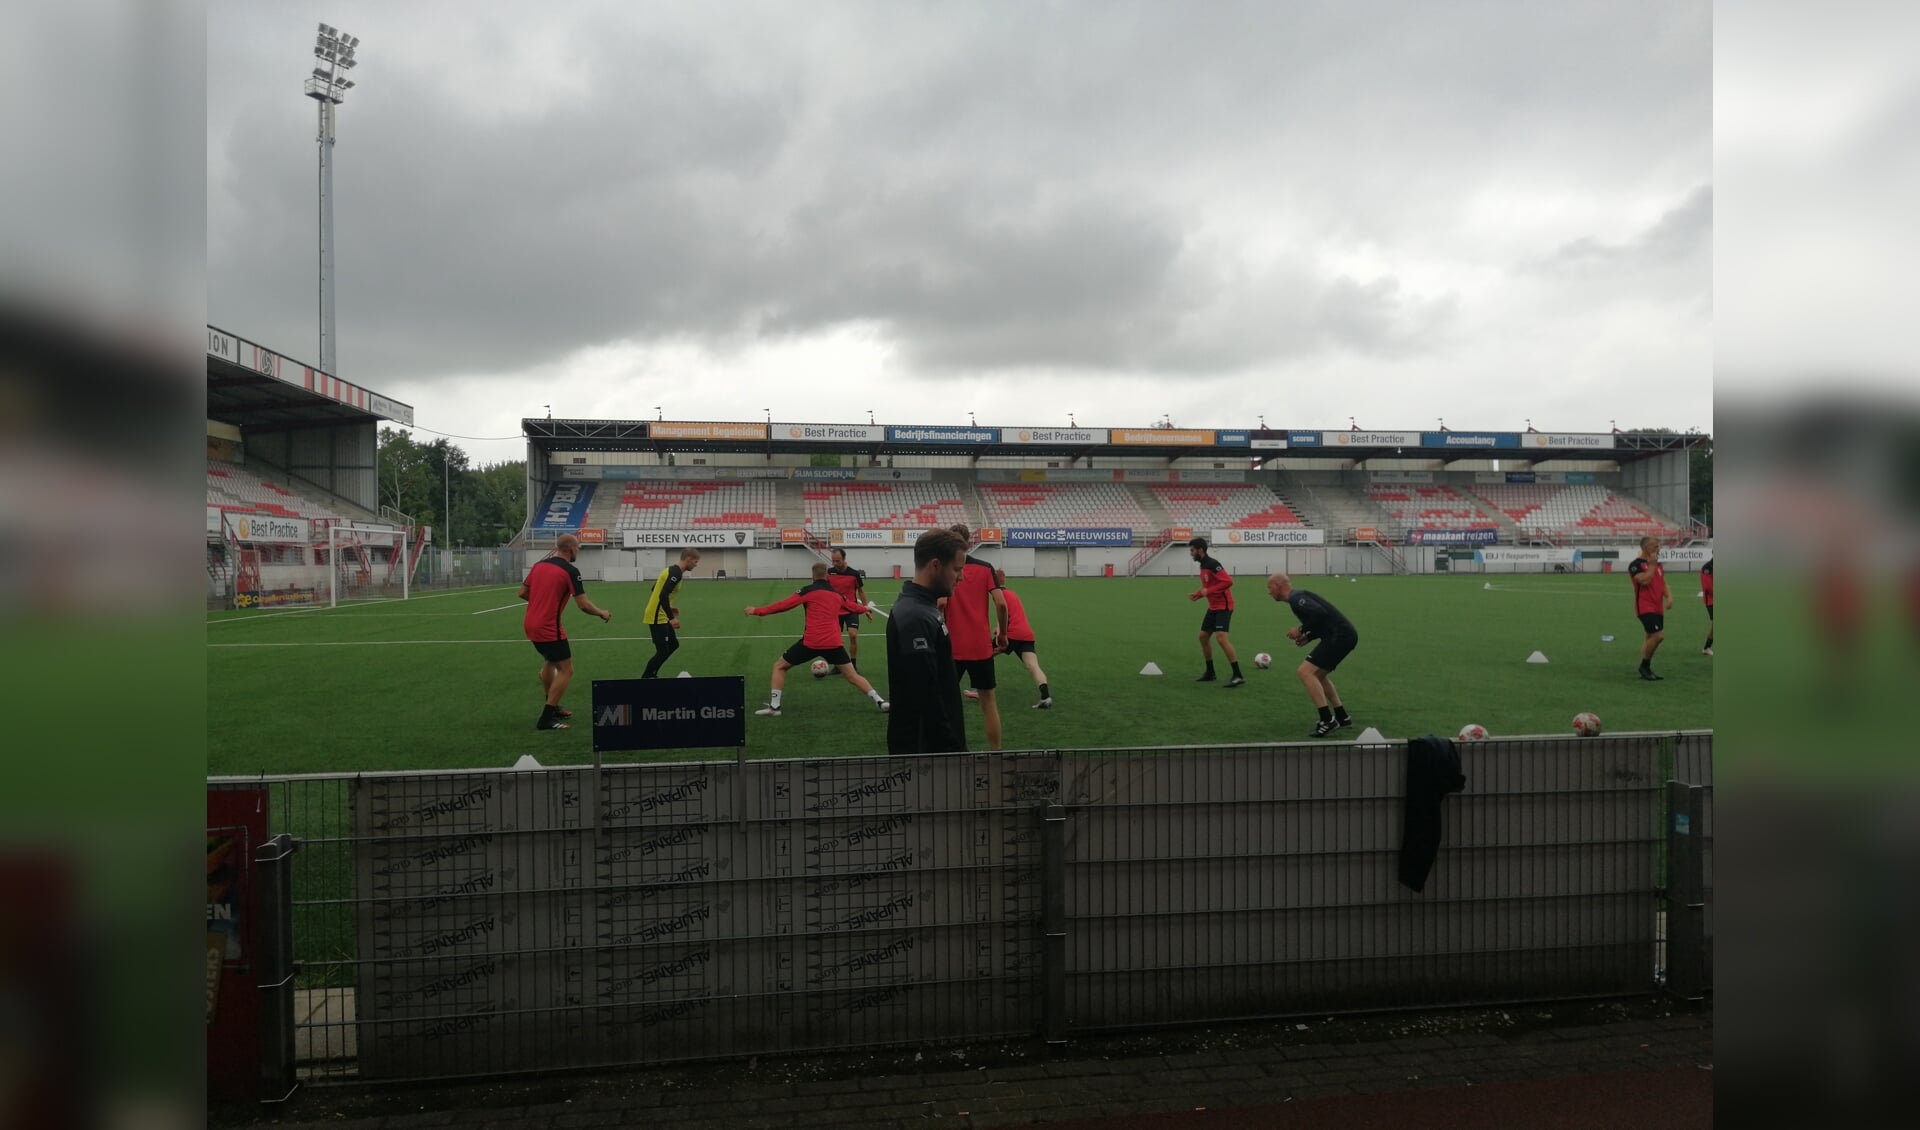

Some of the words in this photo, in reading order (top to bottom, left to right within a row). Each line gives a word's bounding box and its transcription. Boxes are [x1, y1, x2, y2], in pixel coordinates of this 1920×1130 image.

[652, 425, 710, 438] Management
[712, 426, 764, 439] Begeleiding
[804, 428, 826, 438] Best
[828, 428, 867, 439] Practice
[894, 430, 992, 442] Bedrijfsfinancieringen
[1032, 432, 1052, 441] Best
[1055, 432, 1091, 441] Practice
[1350, 434, 1368, 444] Best
[1371, 434, 1405, 444] Practice
[1446, 435, 1496, 447] Accountancy
[1548, 436, 1566, 445] Best
[1568, 436, 1600, 446] Practice
[251, 520, 268, 536] Best
[270, 522, 298, 538] Practice
[988, 530, 994, 538] 2
[636, 534, 680, 544] HEESEN
[682, 534, 726, 544] YACHTS
[846, 532, 882, 540] HENDRIKS
[1012, 532, 1056, 540] KONINGS
[1066, 532, 1128, 540] MEEUWISSEN
[1244, 531, 1265, 542] Best
[1268, 531, 1308, 542] Practice
[1423, 531, 1465, 540] maaskant
[1466, 531, 1494, 540] reizen
[1670, 550, 1704, 560] Practice
[642, 708, 696, 721] Martin
[700, 706, 736, 719] Glas
[841, 768, 912, 804] ALUPANEL
